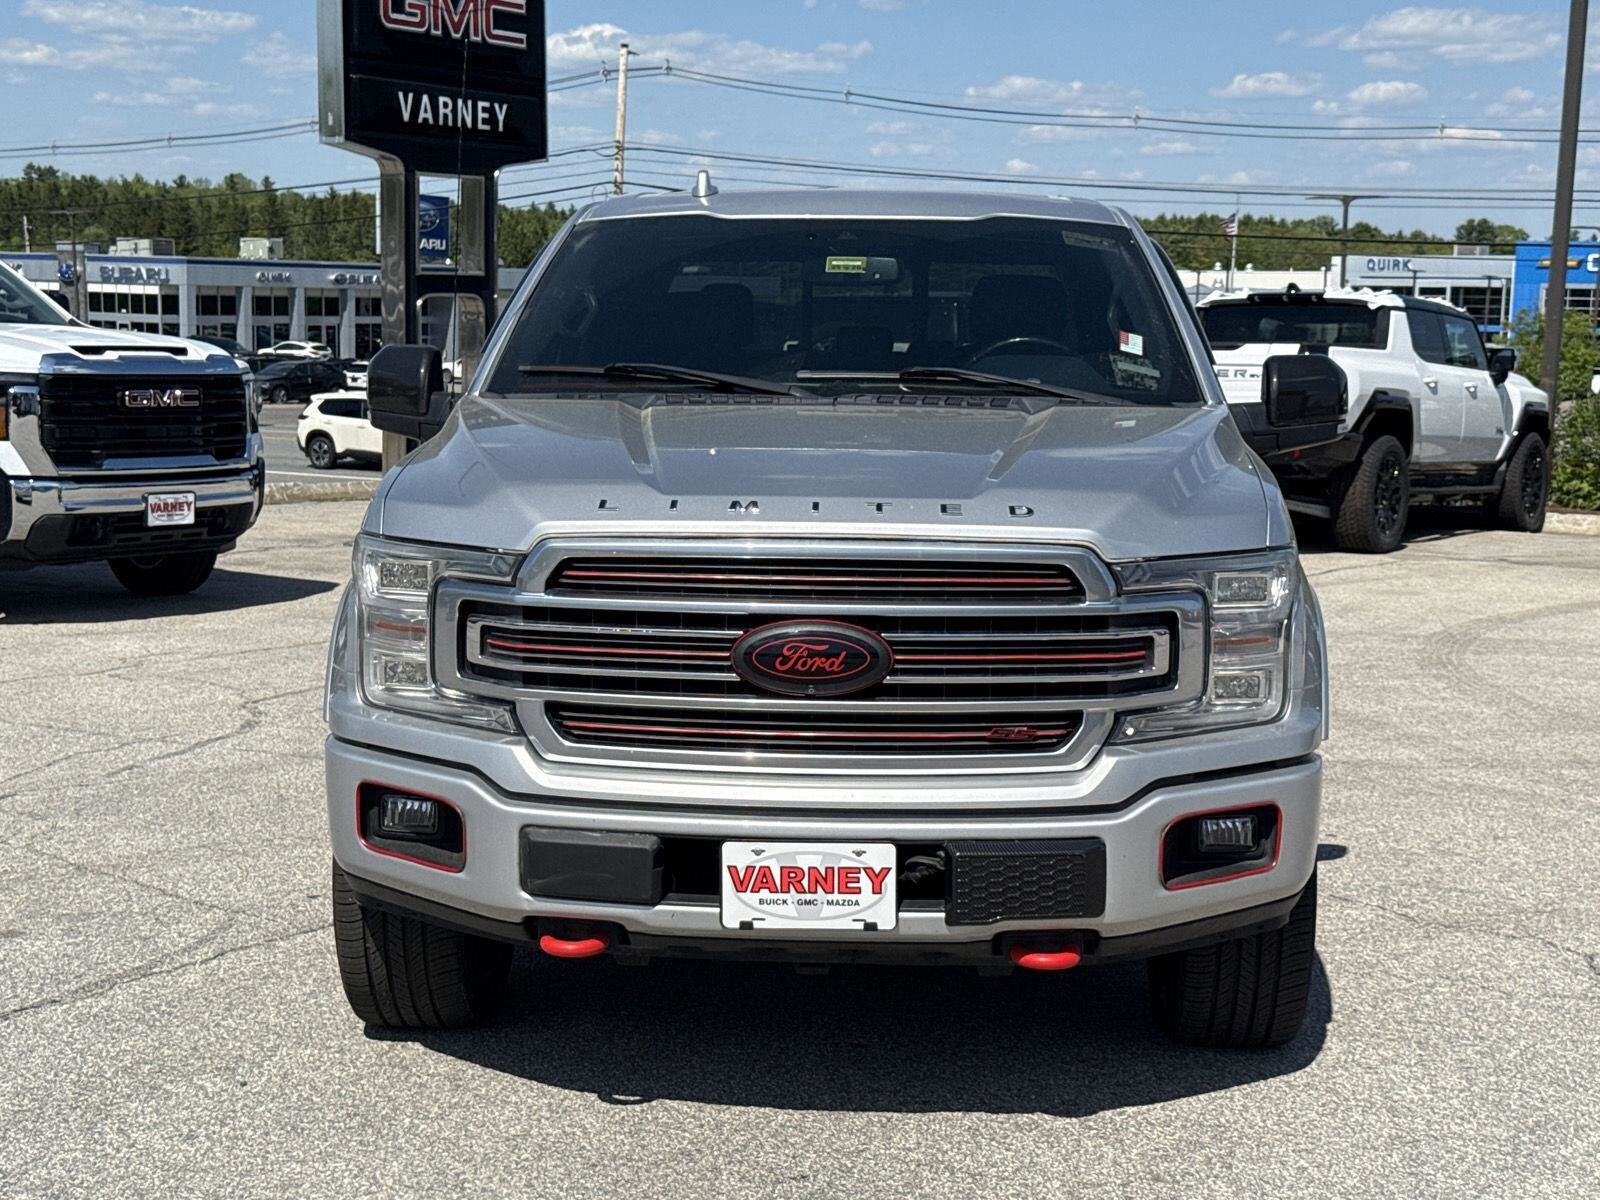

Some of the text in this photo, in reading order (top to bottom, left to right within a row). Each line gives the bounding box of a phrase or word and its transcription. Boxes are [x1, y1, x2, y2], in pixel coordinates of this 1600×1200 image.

[380, 0, 528, 48] GMC
[398, 91, 508, 132] VARNEY
[1366, 258, 1413, 272] QUIRK
[100, 265, 170, 284] SUBARU
[125, 389, 200, 407] GMC
[150, 502, 192, 513] VARNEY
[598, 499, 1035, 517] LIMITED
[775, 642, 847, 672] Ford
[727, 864, 893, 895] VARNEY
[758, 898, 789, 906] BUICK
[796, 899, 819, 907] GMC
[826, 899, 861, 907] MAZDA
